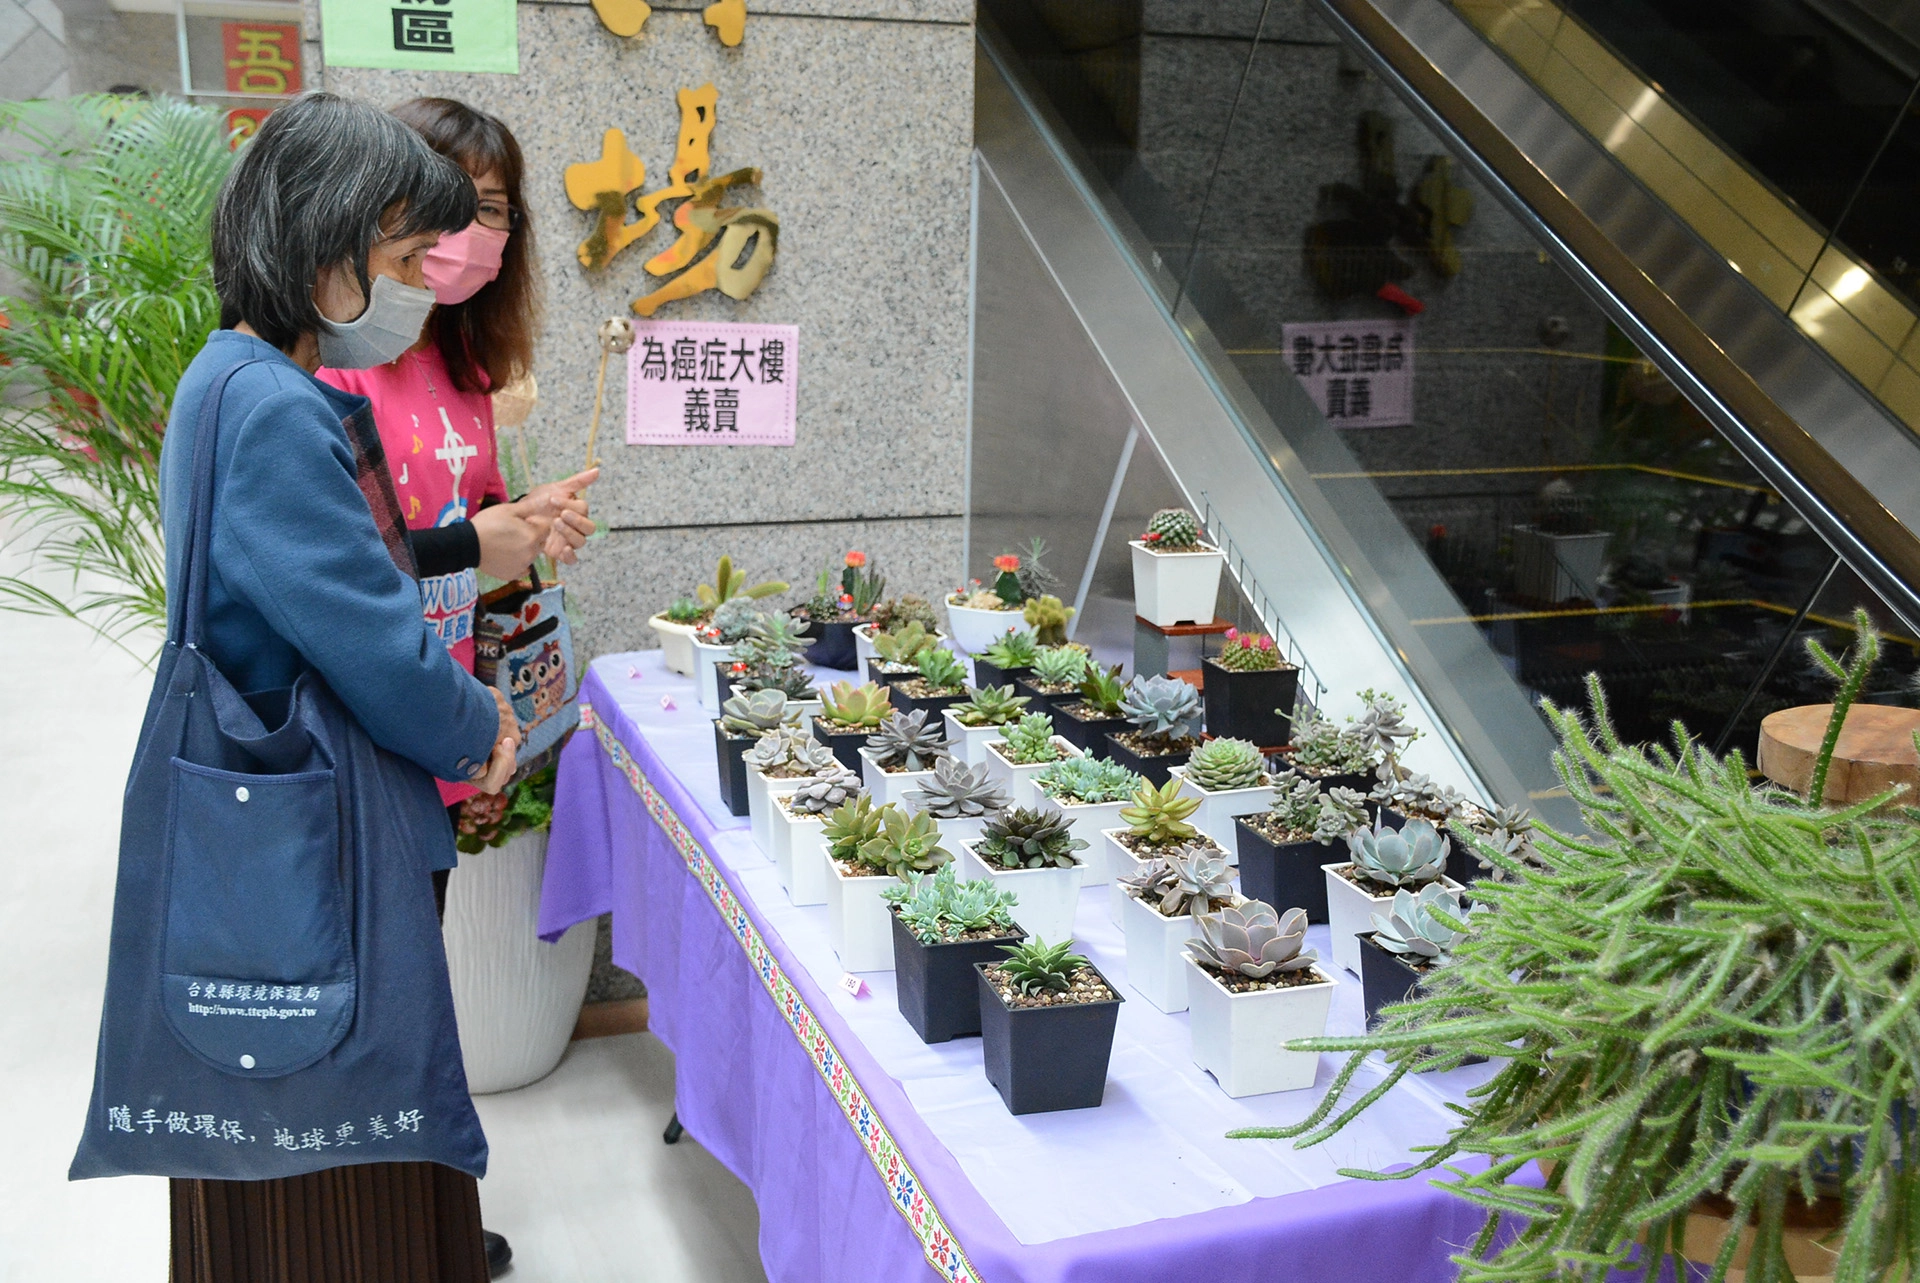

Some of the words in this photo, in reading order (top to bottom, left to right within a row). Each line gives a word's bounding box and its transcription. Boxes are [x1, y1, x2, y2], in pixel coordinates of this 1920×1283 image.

[391, 0, 455, 54] 區
[565, 0, 780, 317] 場
[641, 336, 785, 384] 為癌症大樓
[684, 387, 740, 432] 義賣
[187, 982, 321, 1001] 台東縣環境保護局
